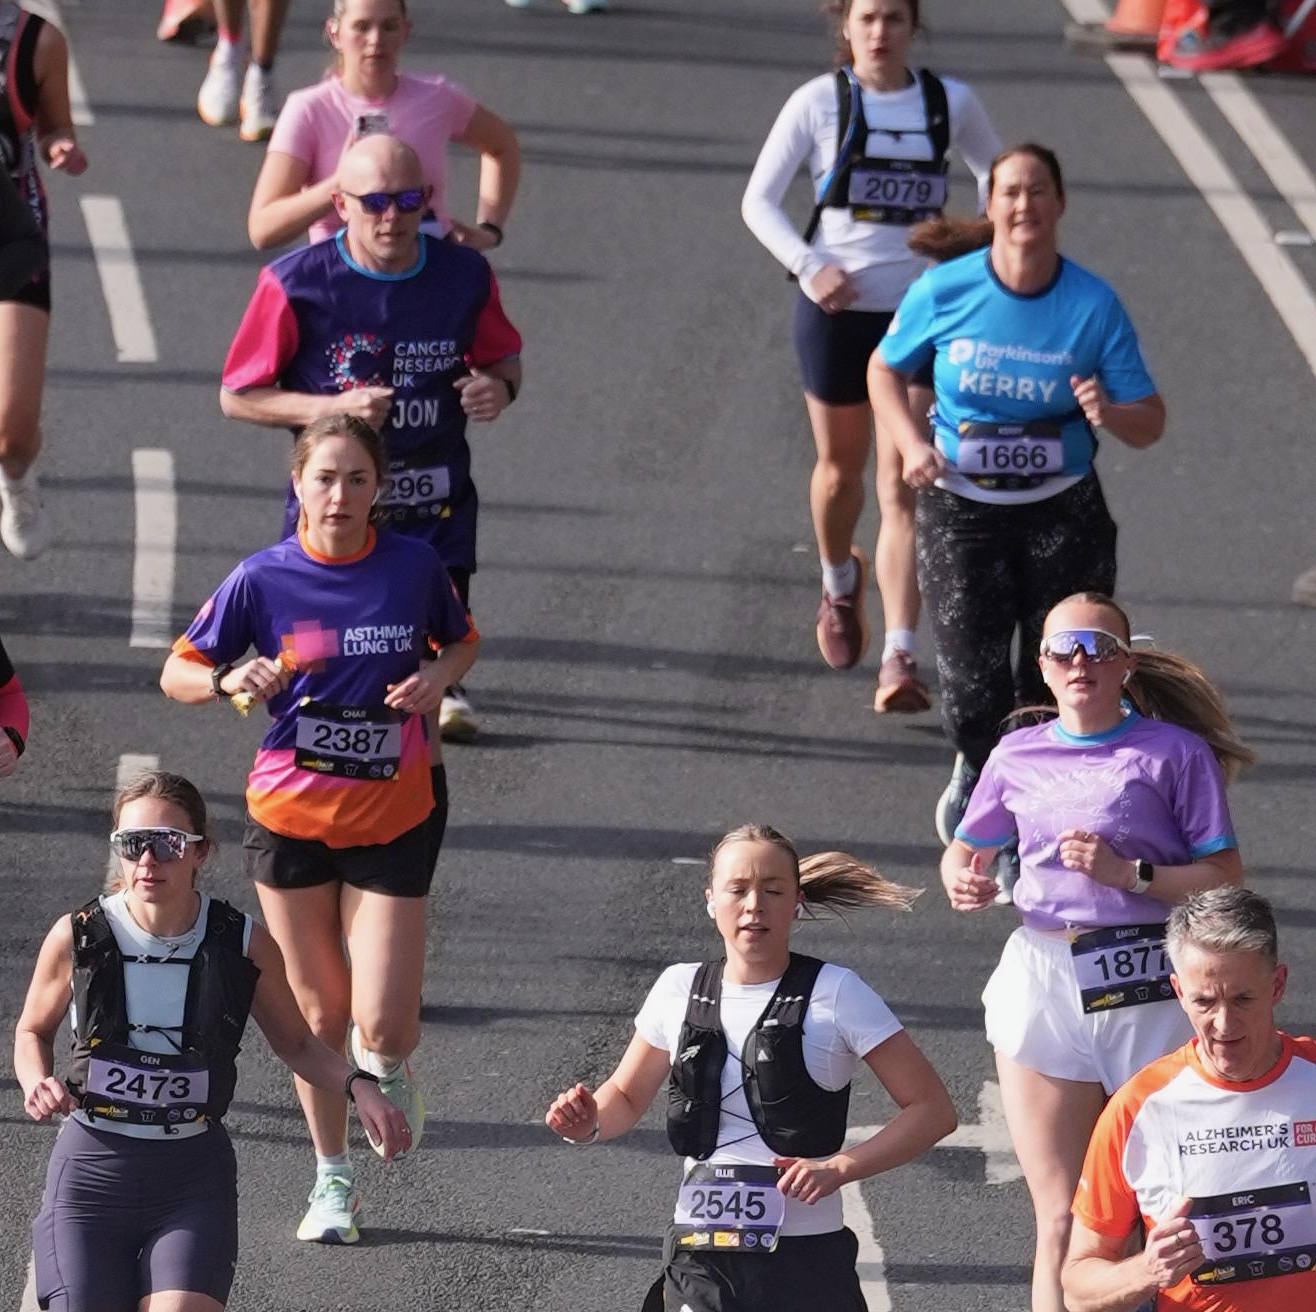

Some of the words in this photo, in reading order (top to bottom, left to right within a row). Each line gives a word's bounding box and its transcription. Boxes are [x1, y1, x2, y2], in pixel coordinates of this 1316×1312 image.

[865, 177, 932, 203] 2079
[394, 341, 456, 356] CANCER
[976, 340, 1073, 366] Parkinson's
[975, 355, 1000, 370] UK
[392, 373, 415, 388] UK
[959, 369, 1058, 403] KERRY
[392, 399, 440, 429] JON
[977, 445, 1048, 469] 1666
[344, 639, 389, 656] LUNG
[394, 637, 413, 652] UK
[312, 724, 389, 754] 2387
[1115, 927, 1141, 939] EMILY
[140, 1055, 161, 1065] GEN
[105, 1067, 191, 1100] 2473
[1185, 1123, 1289, 1142] ALZHEIMER'S
[1295, 1124, 1313, 1134] FOR
[1180, 1139, 1263, 1156] RESEARCH
[1267, 1136, 1290, 1149] UK
[690, 1189, 766, 1221] 2545
[1231, 1194, 1255, 1207] ERIC
[1213, 1214, 1285, 1253] 378
